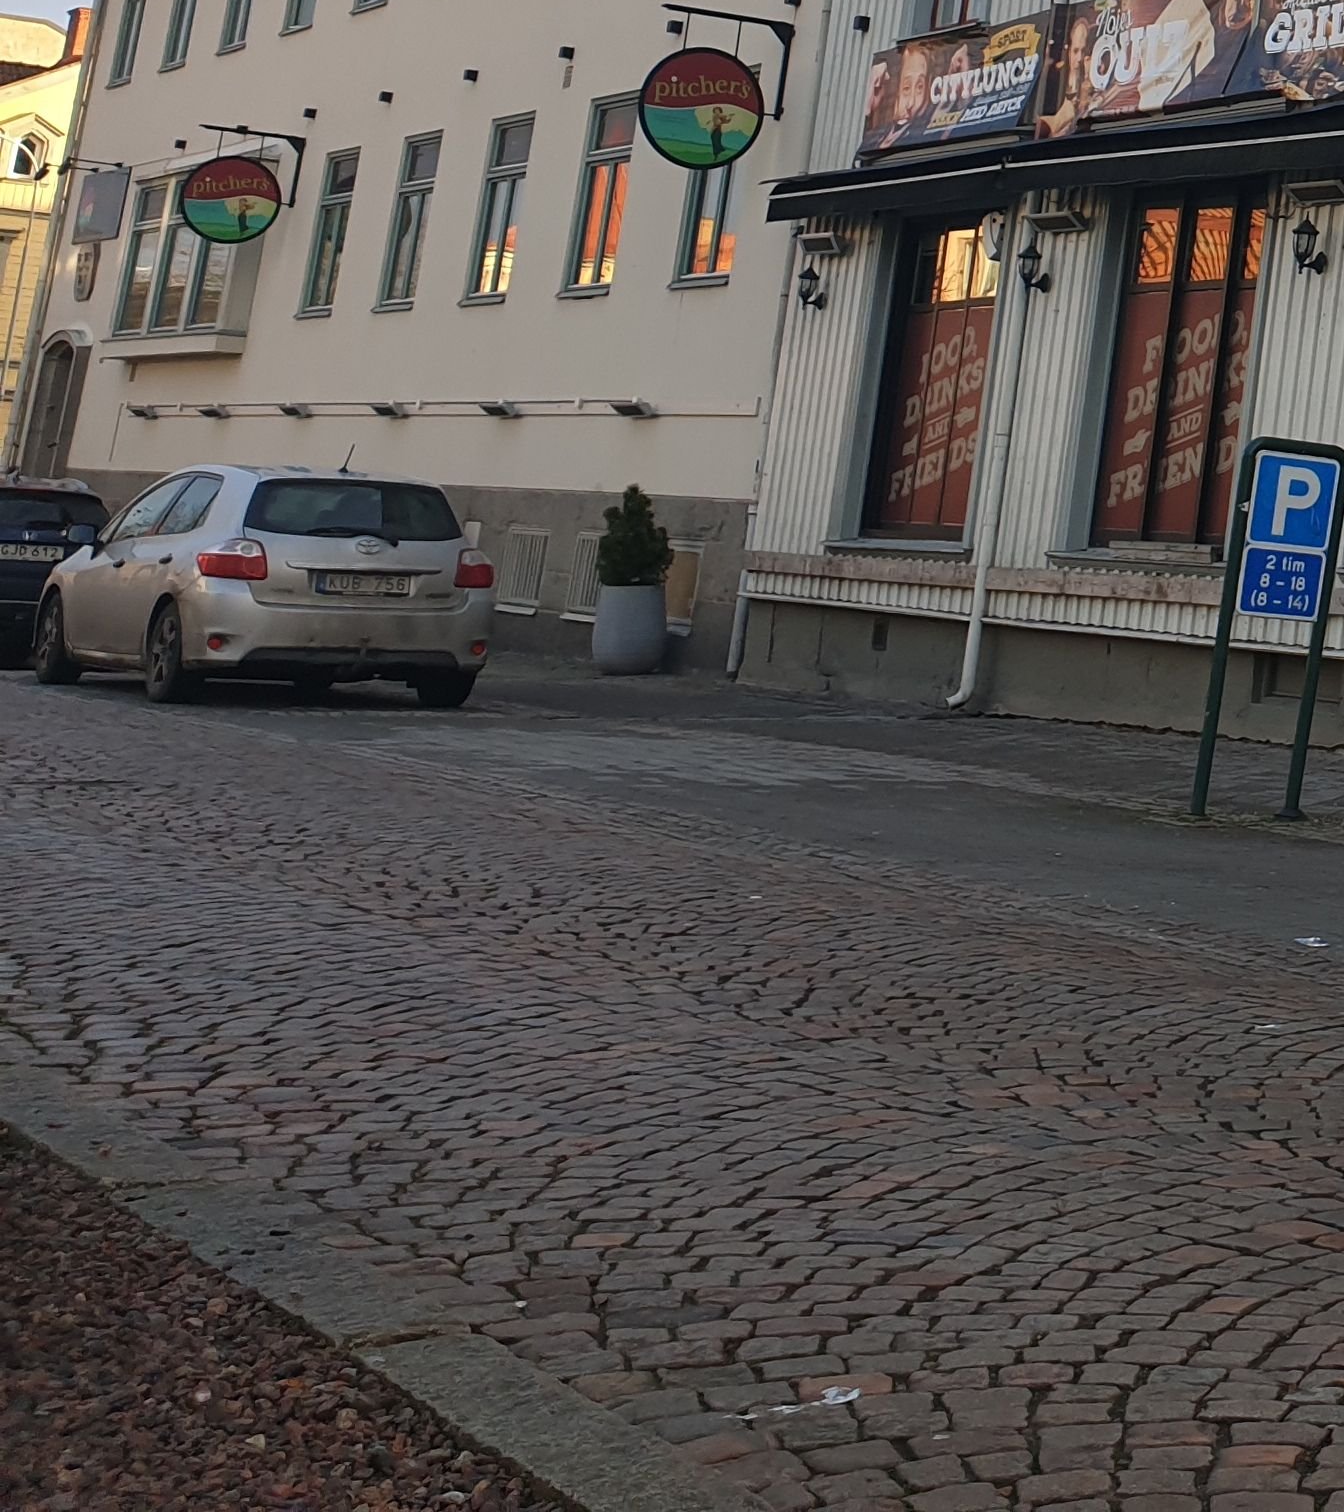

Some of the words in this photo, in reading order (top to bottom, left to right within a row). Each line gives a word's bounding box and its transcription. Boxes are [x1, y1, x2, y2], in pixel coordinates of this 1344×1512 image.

[930, 53, 1039, 104] CITYLUNCH
[1168, 411, 1203, 440] AND
[1271, 465, 1321, 536] P
[32, 547, 58, 557] 612
[1265, 555, 1276, 570] 2
[1282, 556, 1305, 573] tim
[329, 575, 360, 590] KUB
[374, 577, 405, 592] 756
